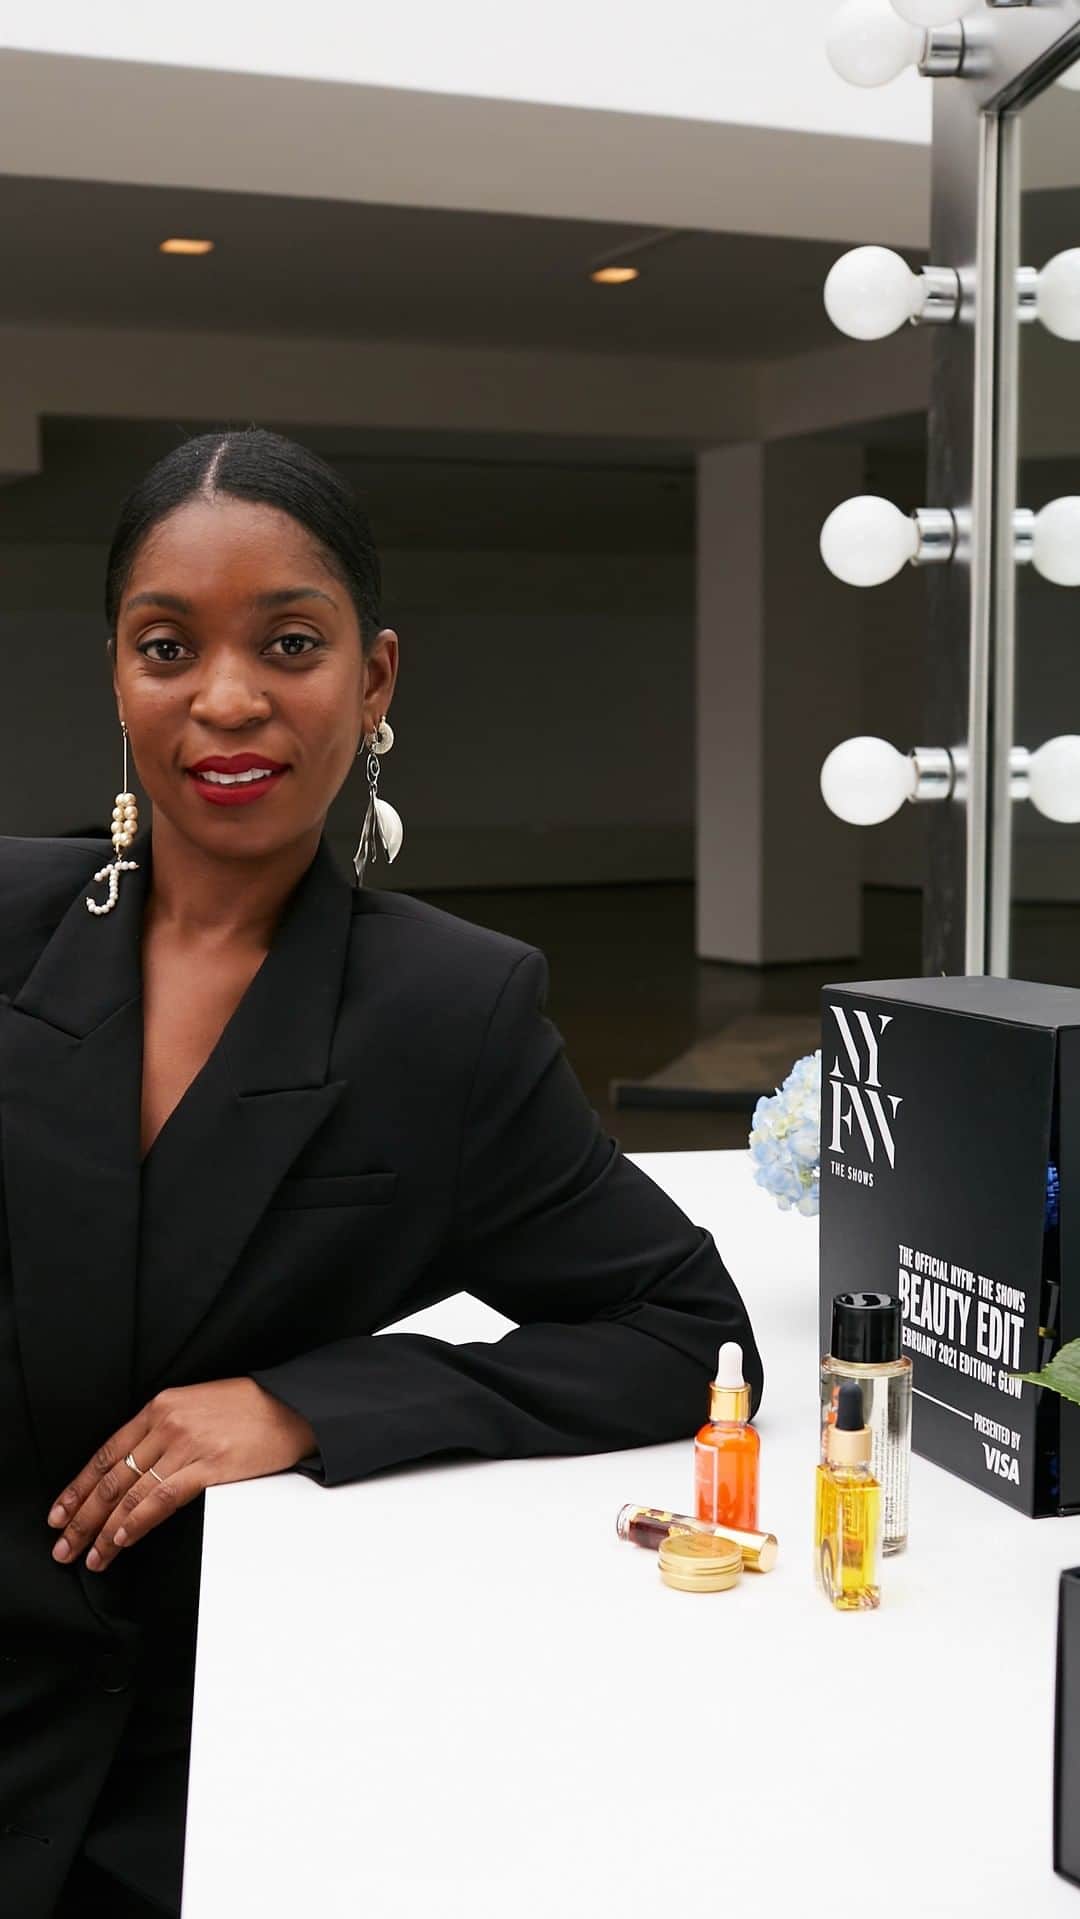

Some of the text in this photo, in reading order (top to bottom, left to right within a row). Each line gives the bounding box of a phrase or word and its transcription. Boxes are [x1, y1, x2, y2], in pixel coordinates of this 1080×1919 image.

[831, 1160, 874, 1187] THE SHOWS
[899, 1244, 1026, 1313] THE OFFICIAL NYFW: THE SHOWS
[899, 1268, 1024, 1370] BEAUTY EDIT
[902, 1325, 1023, 1400] EBRUARY 2021 EDITION: GLOW
[974, 1412, 1021, 1451] PRESENTED BY
[982, 1442, 1020, 1485] VISA
